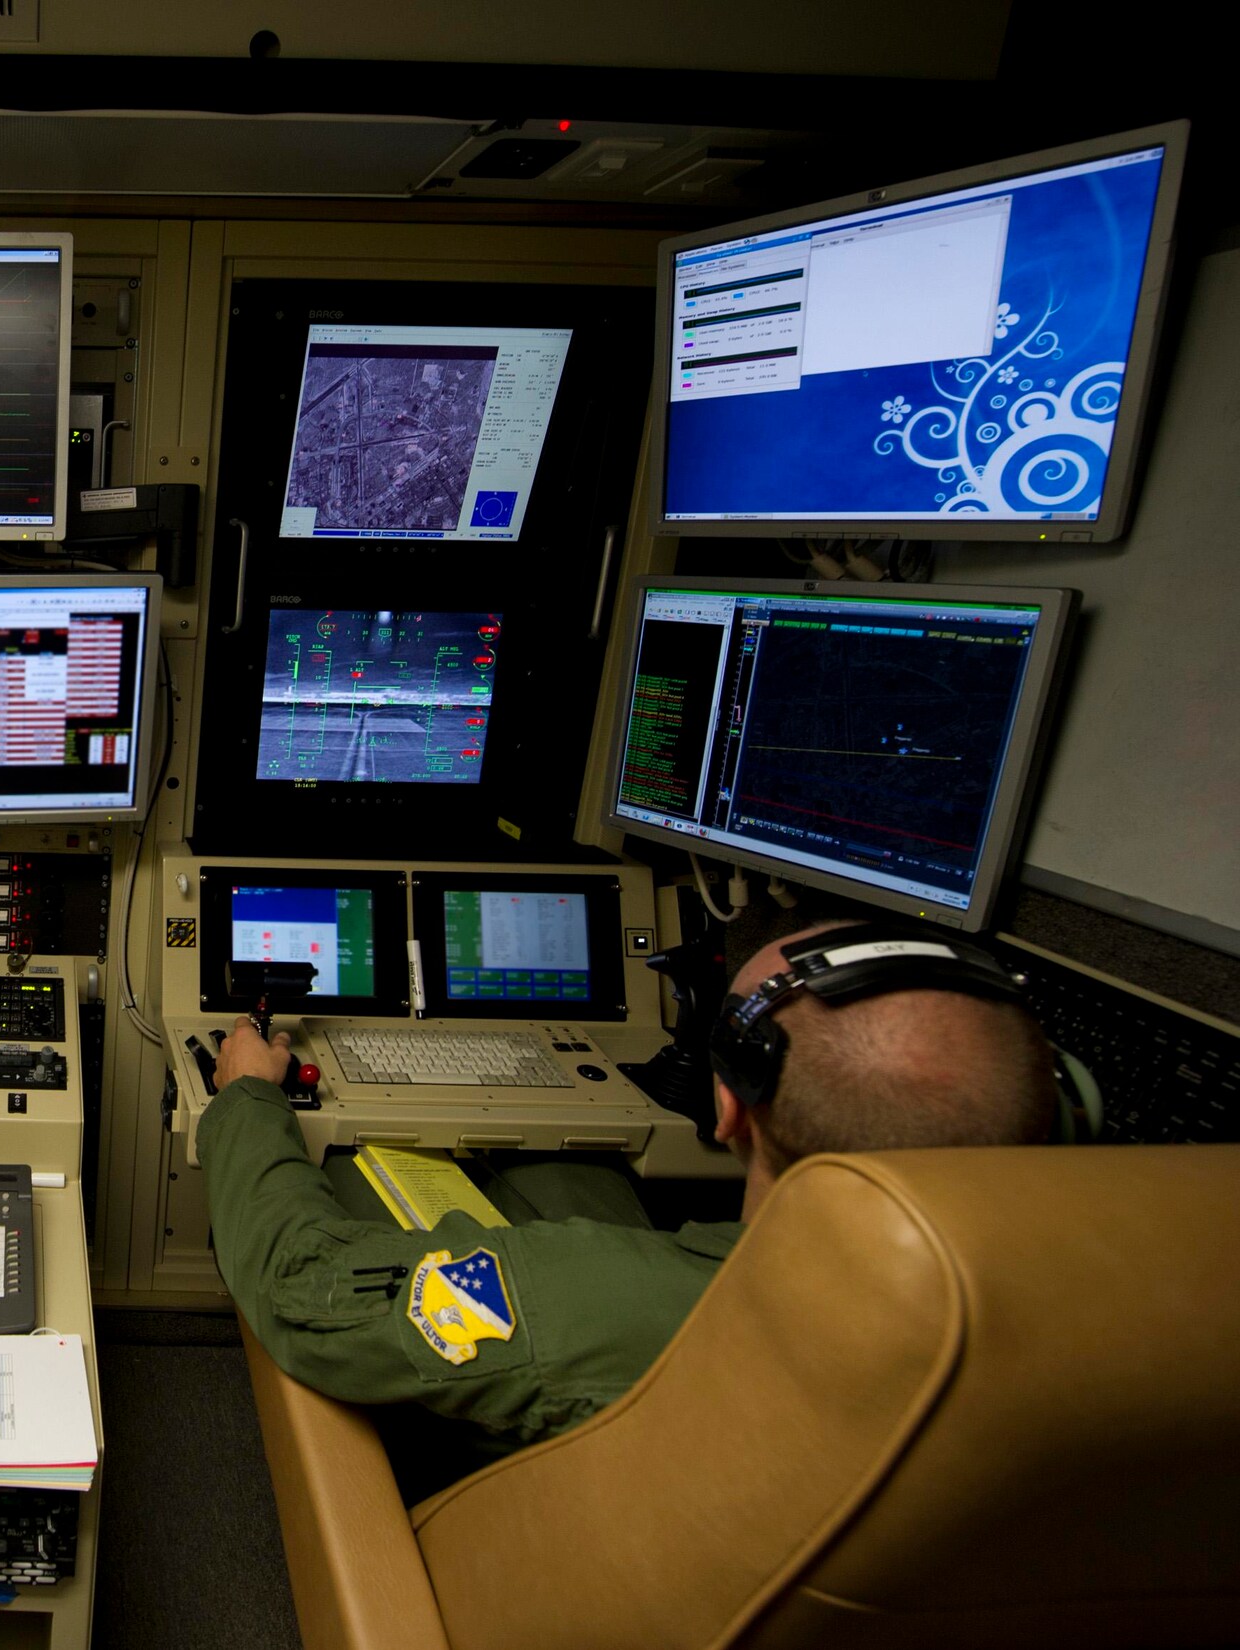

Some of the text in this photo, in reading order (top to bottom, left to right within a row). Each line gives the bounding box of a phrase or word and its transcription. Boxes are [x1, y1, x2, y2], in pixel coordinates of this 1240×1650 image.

[410, 1266, 448, 1353] TUTOR ET ULTOR
